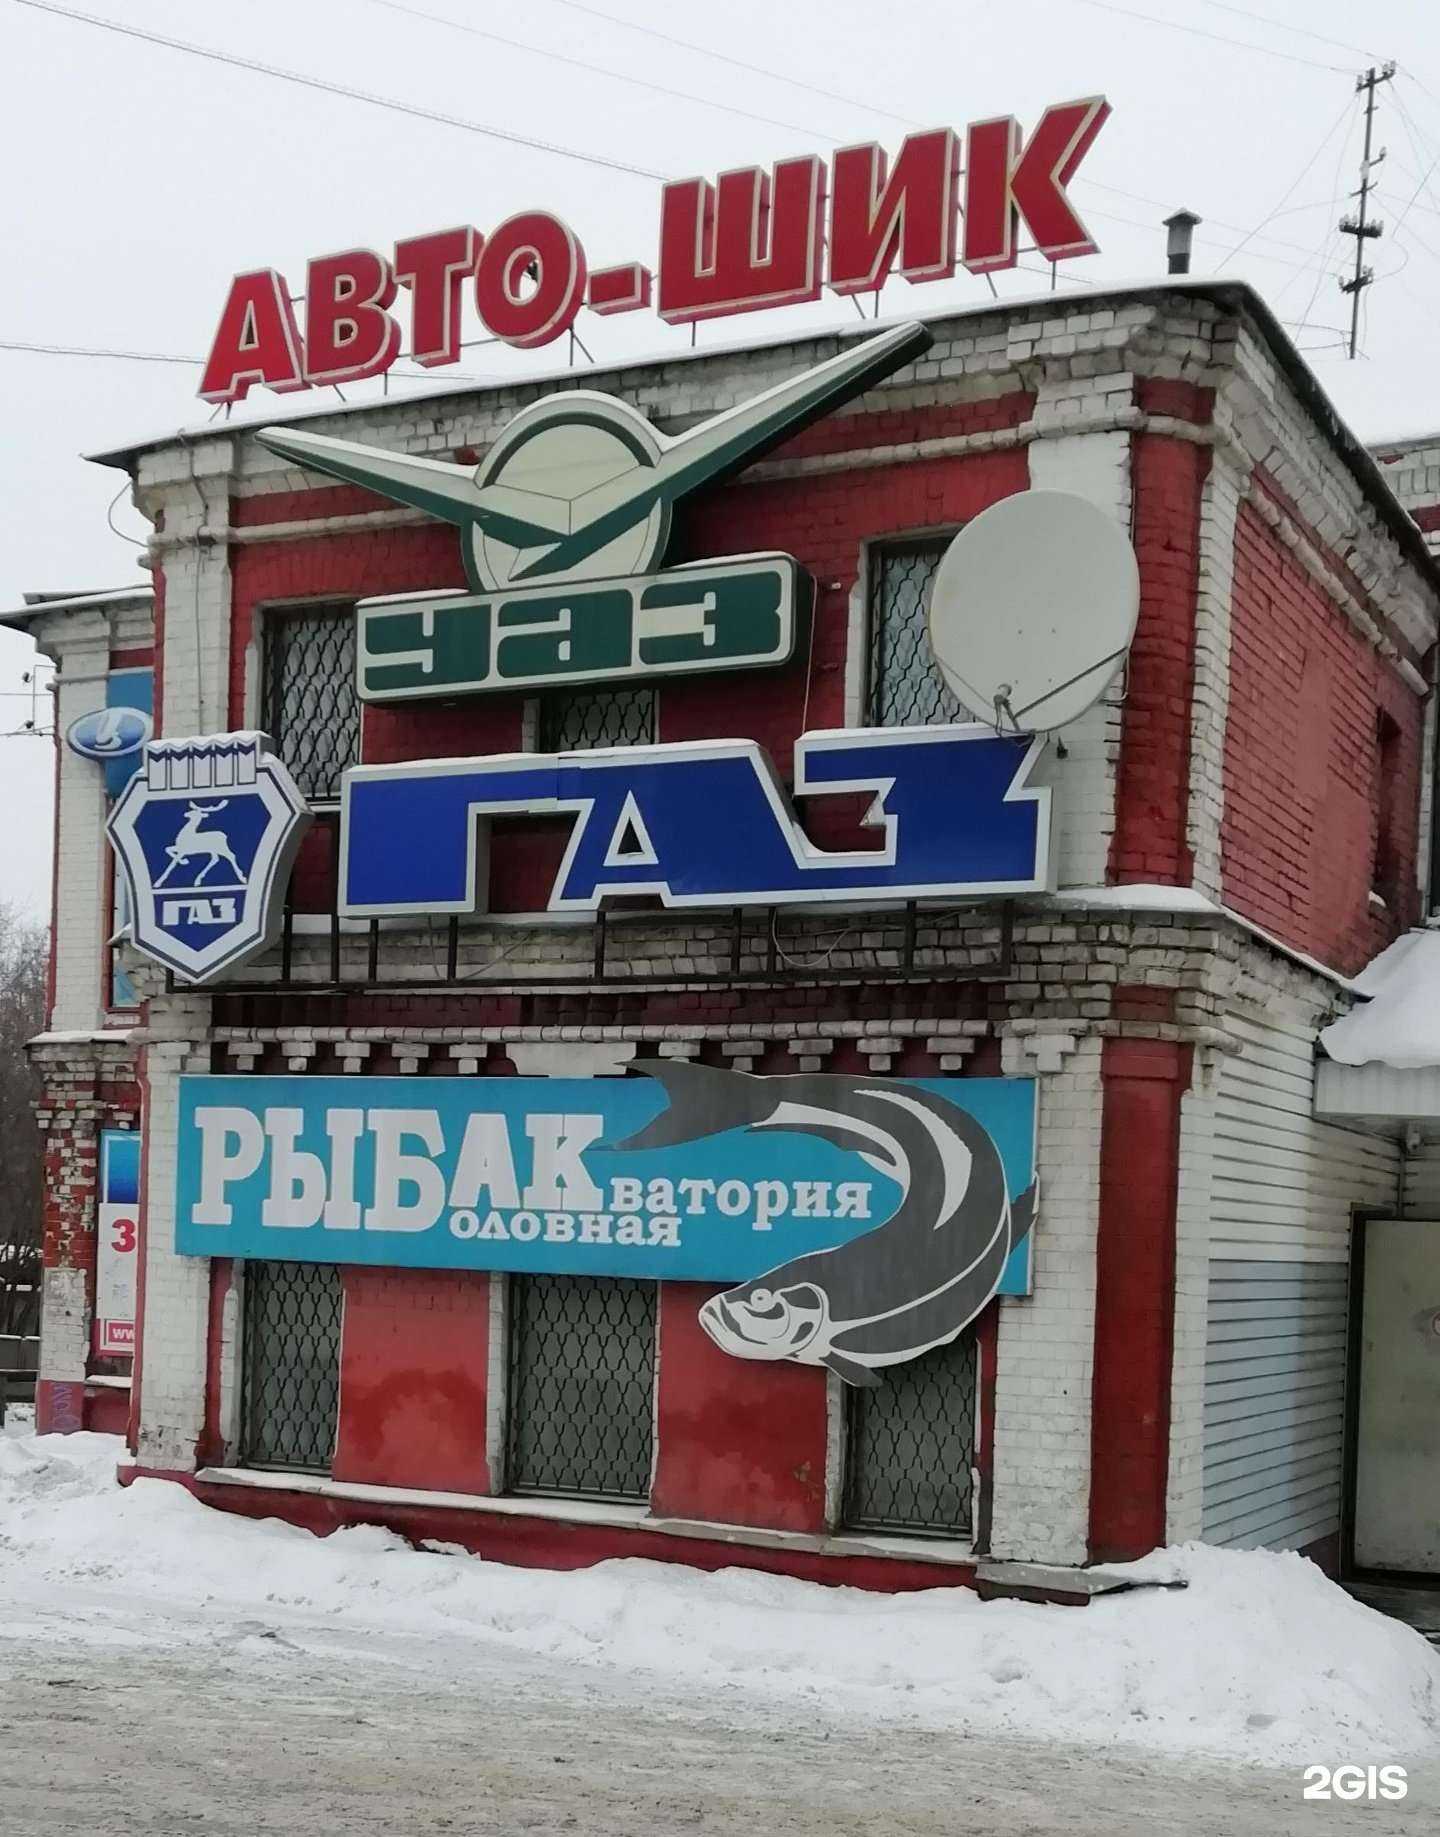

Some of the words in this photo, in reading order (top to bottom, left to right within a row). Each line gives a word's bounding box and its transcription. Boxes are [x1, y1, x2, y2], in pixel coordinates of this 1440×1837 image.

[197, 94, 1112, 403] АВТО-ШИК
[338, 723, 1056, 919] ГАЗ
[162, 897, 236, 926] ГАЗ
[449, 1209, 683, 1248] оловная
